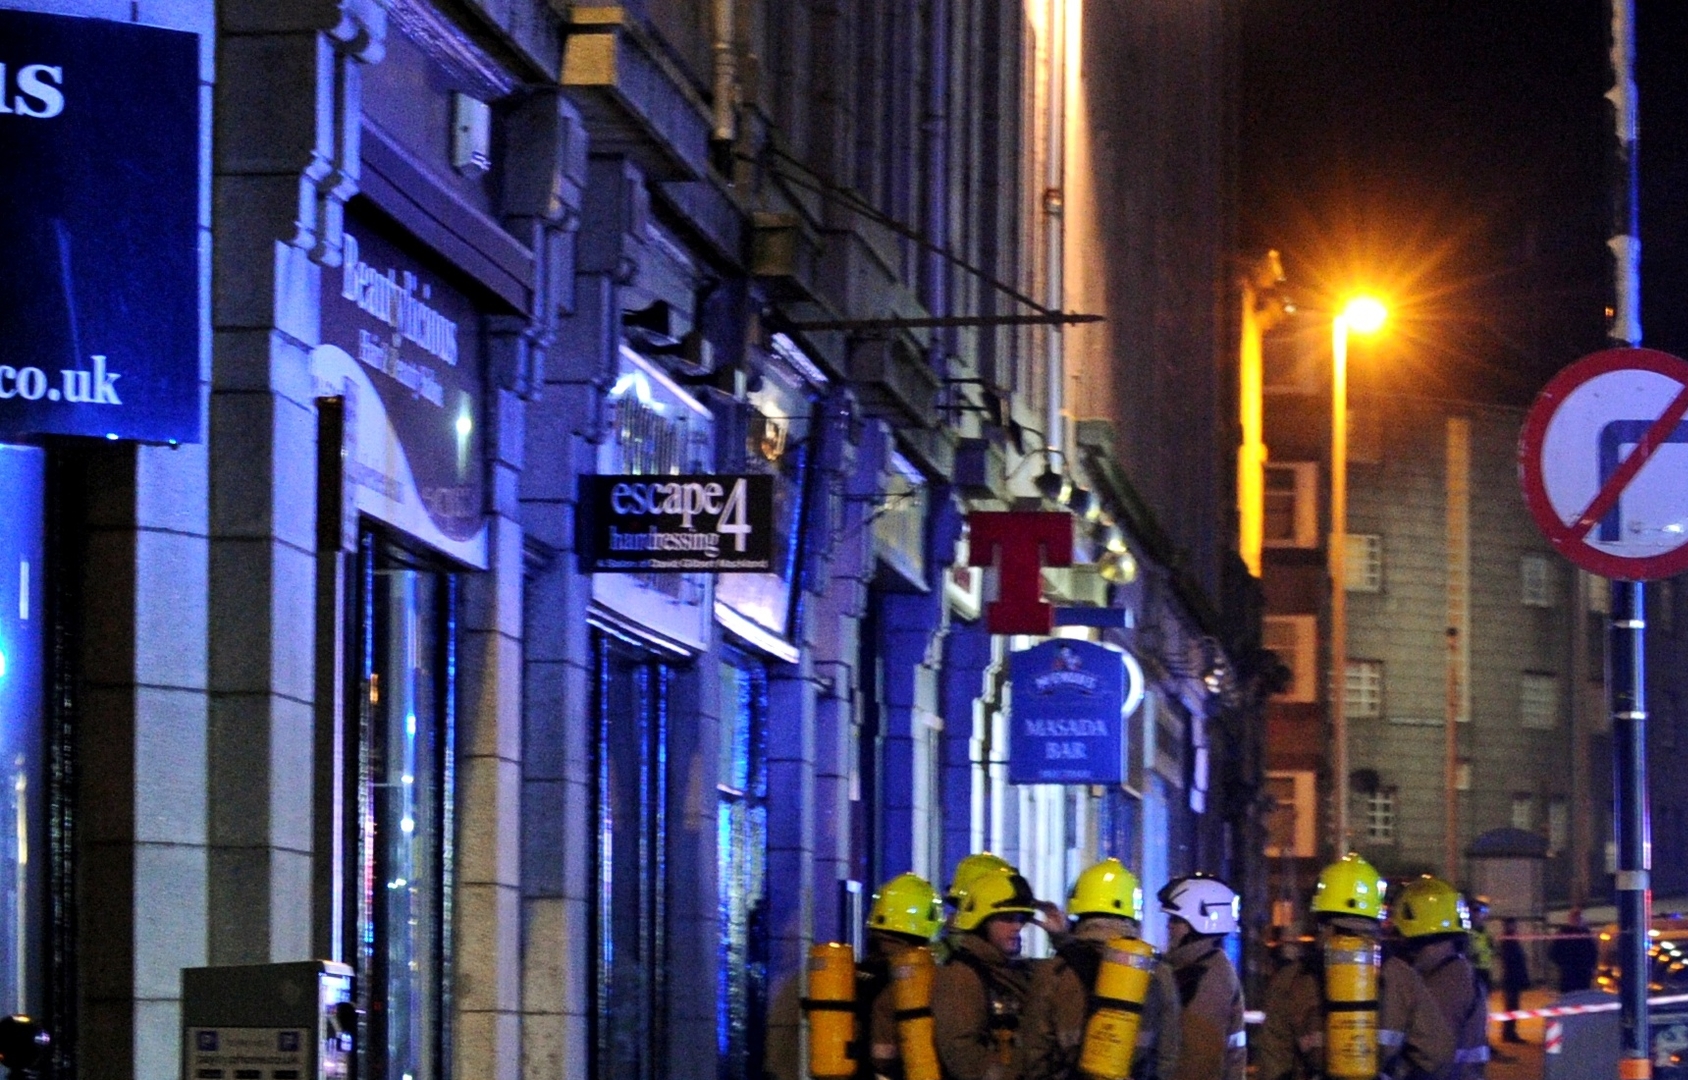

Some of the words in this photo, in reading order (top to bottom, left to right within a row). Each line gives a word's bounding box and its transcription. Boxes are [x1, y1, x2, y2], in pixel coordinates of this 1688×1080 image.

[610, 482, 724, 528] escape
[716, 477, 752, 552] 4
[609, 524, 721, 558] hairdressing
[1024, 718, 1109, 737] MASADA
[1044, 741, 1088, 760] BAR
